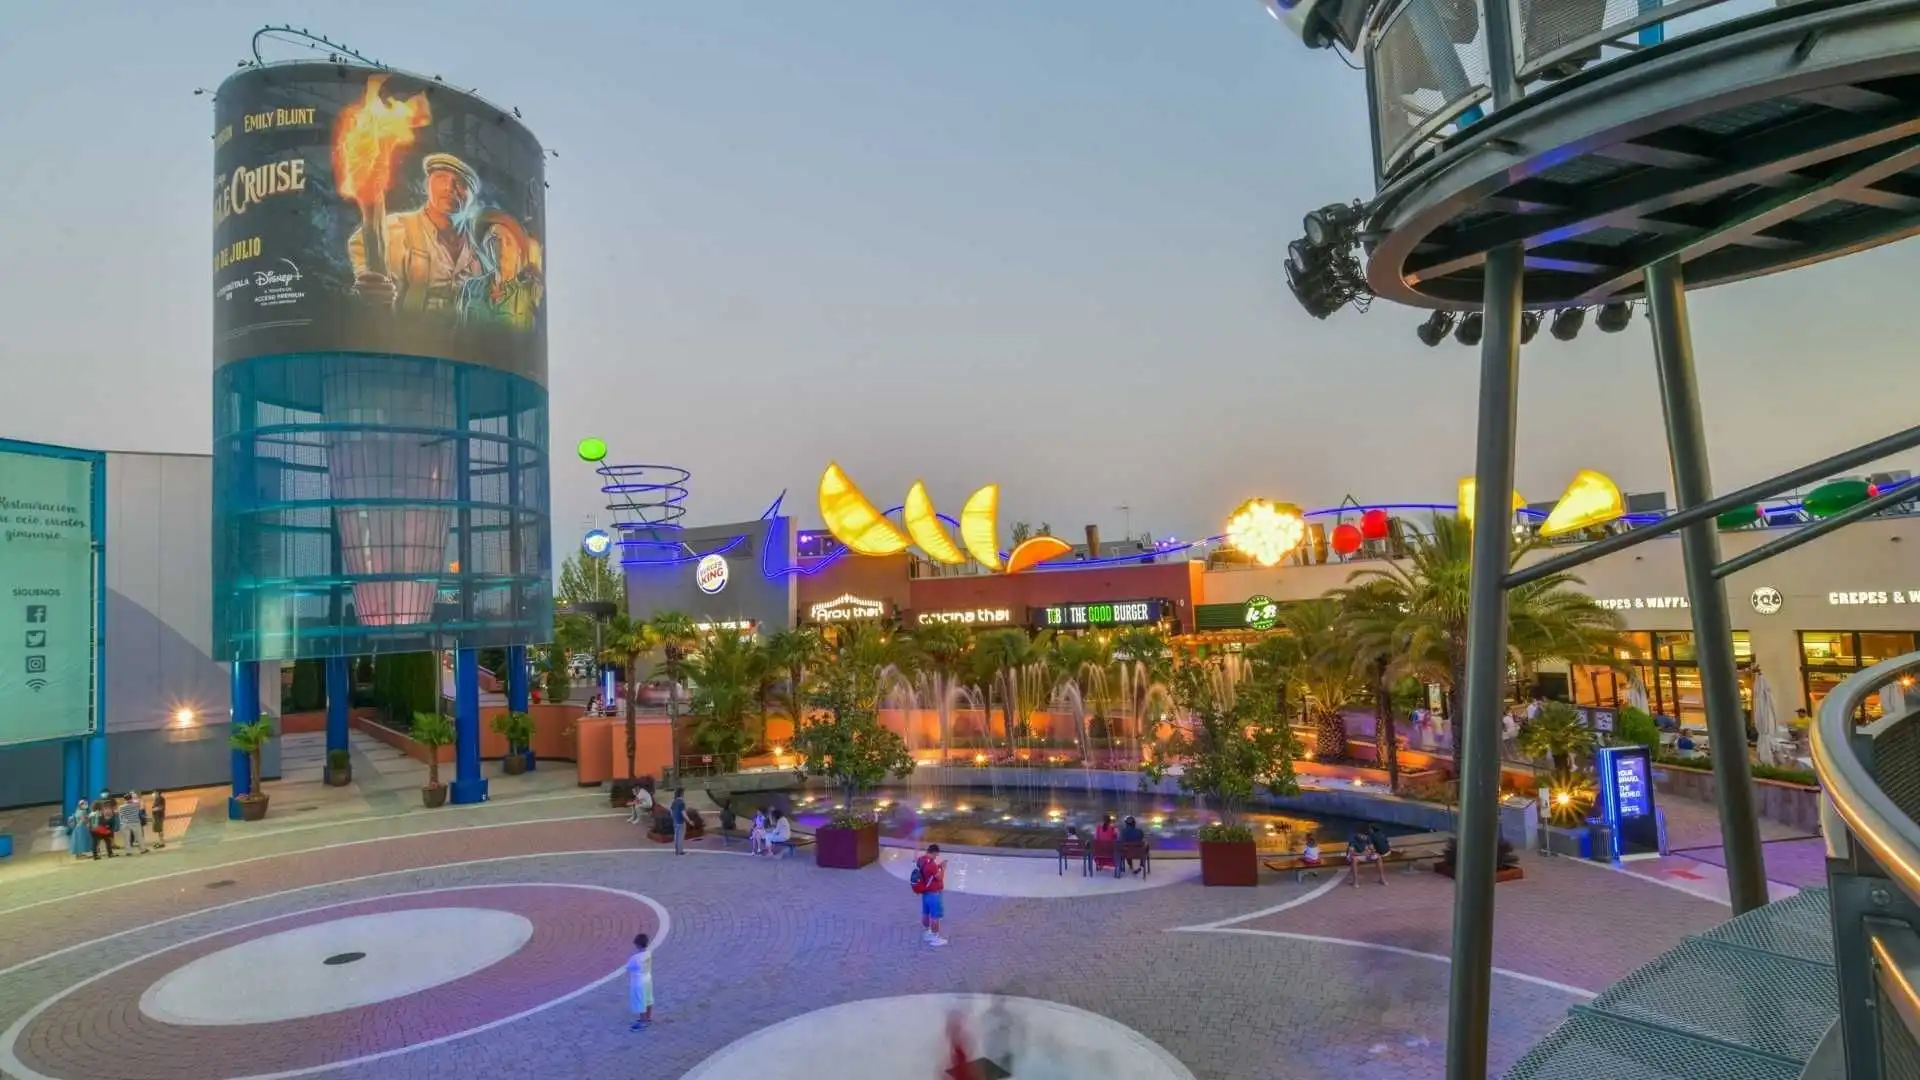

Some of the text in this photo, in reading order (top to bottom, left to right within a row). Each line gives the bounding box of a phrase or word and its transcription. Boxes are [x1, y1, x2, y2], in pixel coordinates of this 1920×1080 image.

[244, 108, 316, 133] EMILY BLUNT
[231, 159, 307, 214] CRUISE
[230, 237, 261, 264] JULIO
[701, 568, 724, 585] KING
[1635, 597, 1645, 608] &
[1828, 591, 1888, 605] CREPES
[1893, 591, 1906, 604] &
[978, 608, 1010, 622] thai
[1045, 603, 1149, 624] TGB THE GOOD BURGER
